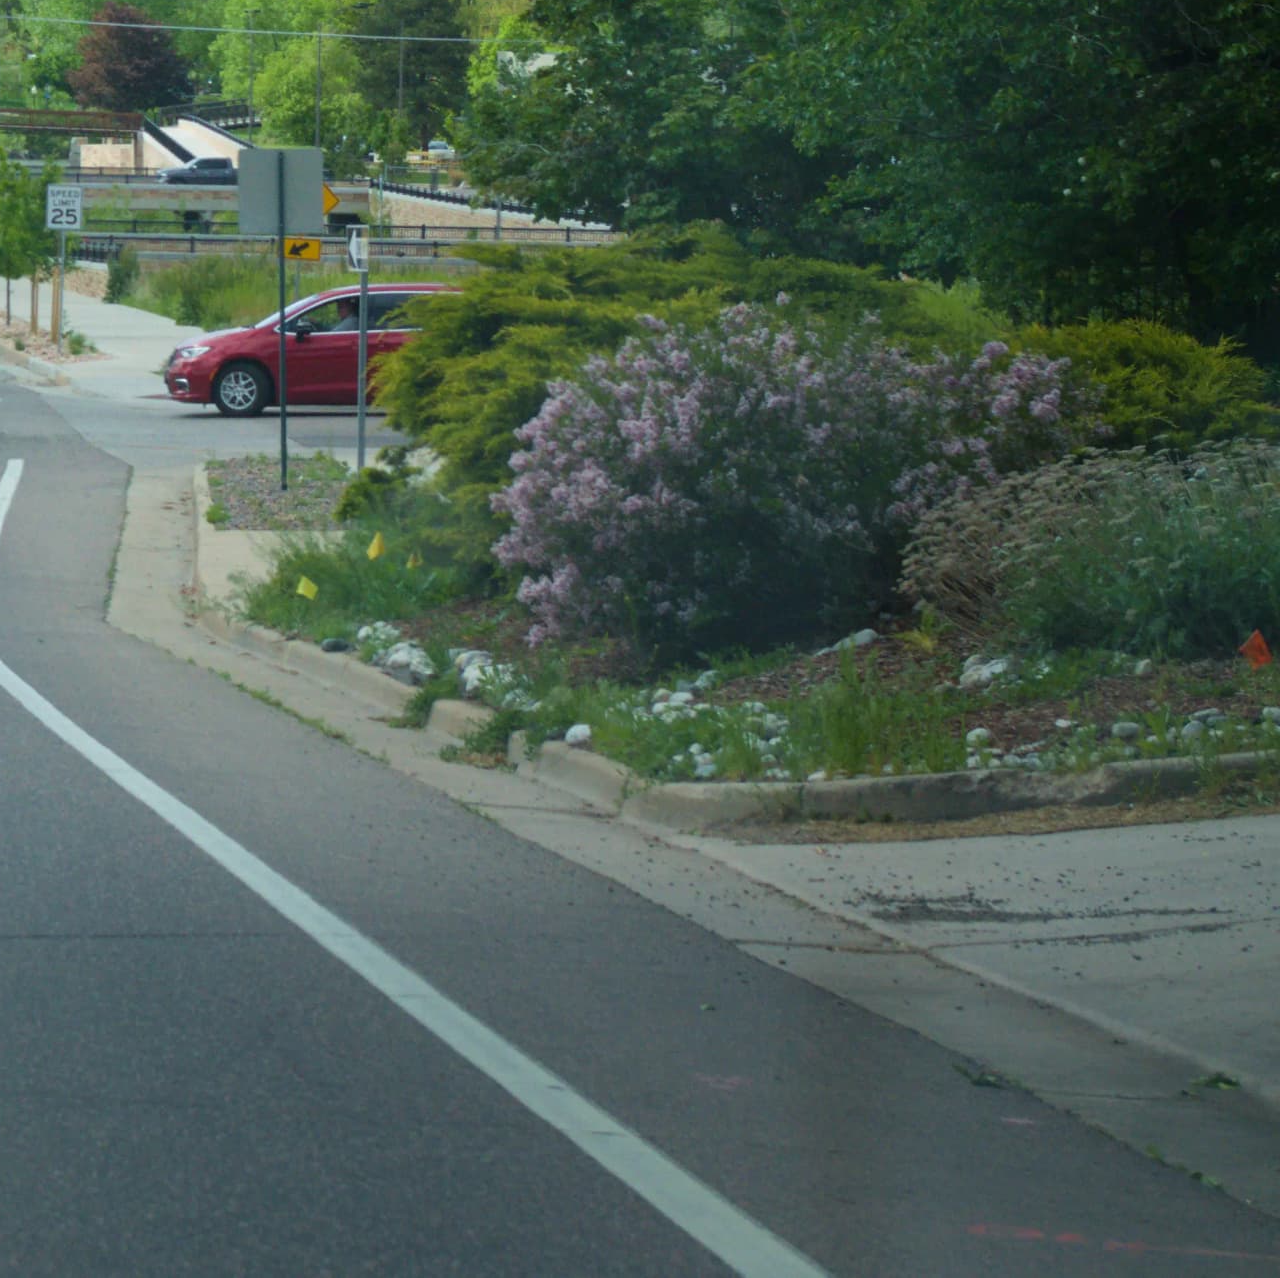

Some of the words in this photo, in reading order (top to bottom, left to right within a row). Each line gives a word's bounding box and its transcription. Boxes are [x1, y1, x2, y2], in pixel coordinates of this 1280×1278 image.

[50, 190, 80, 198] SPEED
[52, 199, 77, 207] LIMIT
[51, 208, 78, 225] 25
